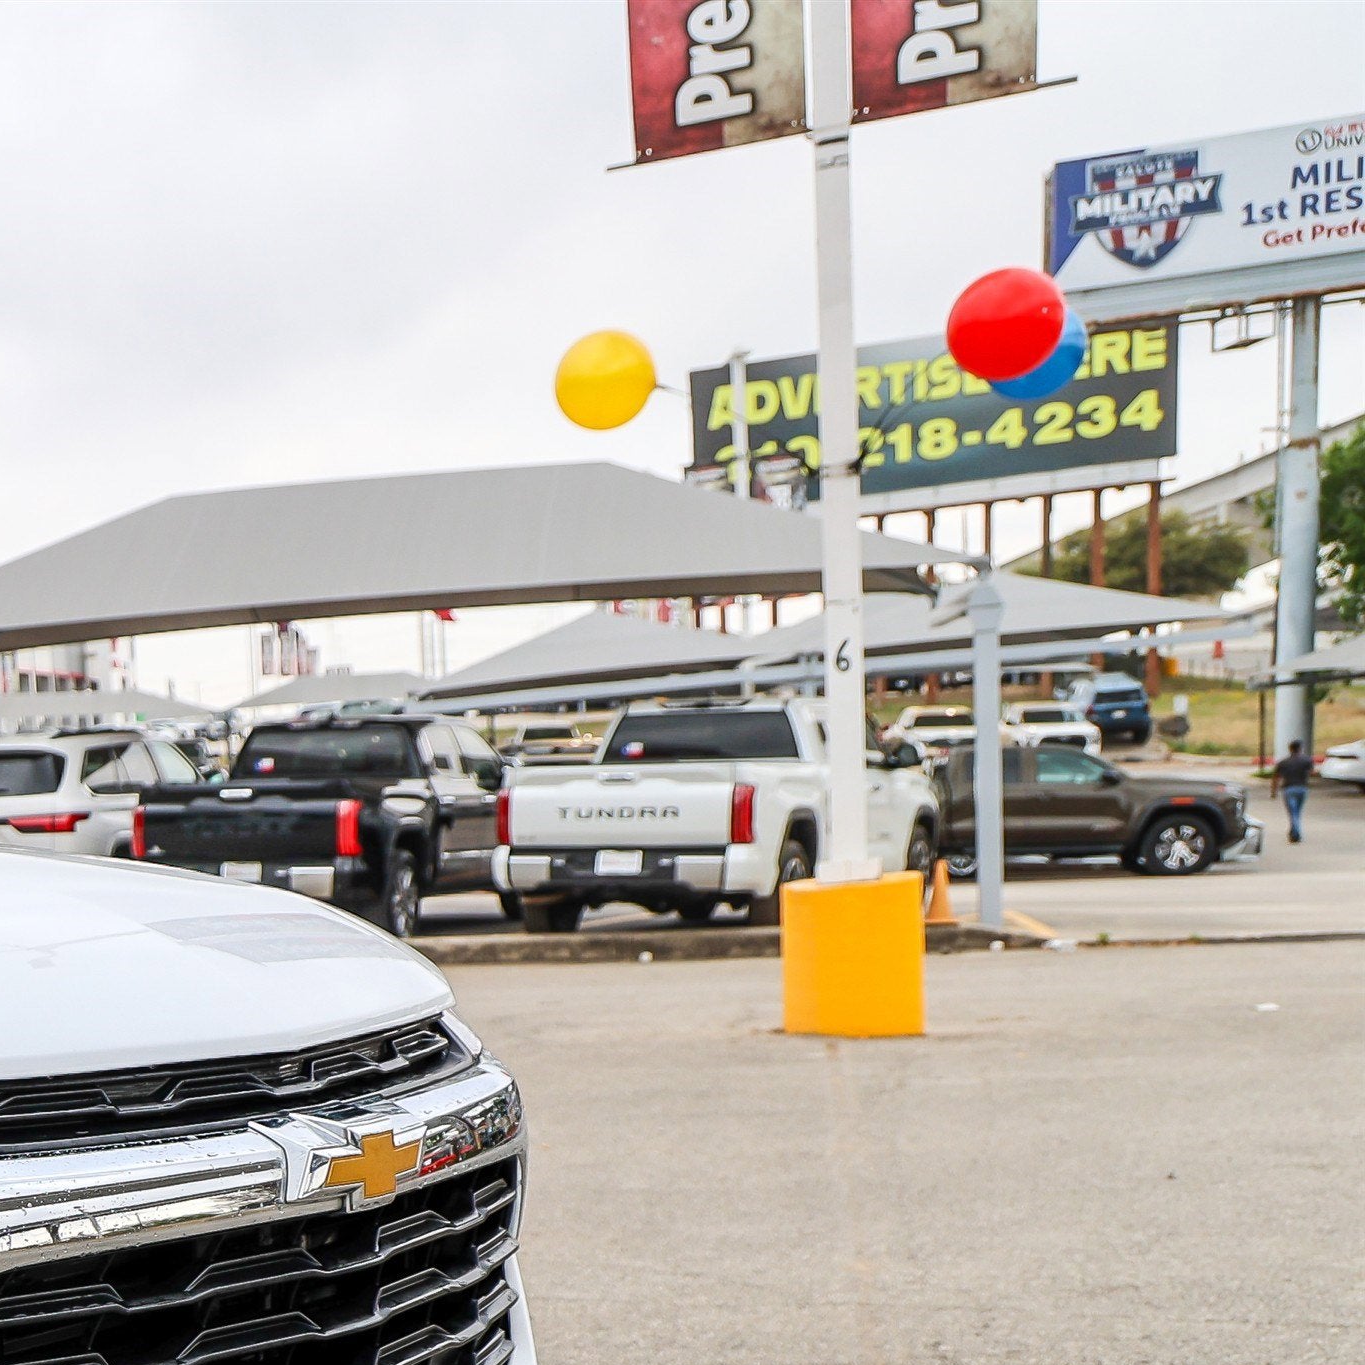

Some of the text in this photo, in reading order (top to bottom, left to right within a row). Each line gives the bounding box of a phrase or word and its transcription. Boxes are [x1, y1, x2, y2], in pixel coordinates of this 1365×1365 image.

[897, 0, 981, 85] Pr
[675, 0, 754, 127] Pre
[1291, 155, 1364, 189] MILI
[1076, 178, 1216, 221] MILITARY
[1240, 185, 1364, 226] 1st RES
[1262, 229, 1302, 248] Get
[707, 327, 1167, 432] ADVRTIS RE
[835, 639, 850, 672] 6
[556, 805, 681, 820] TUNDRA
